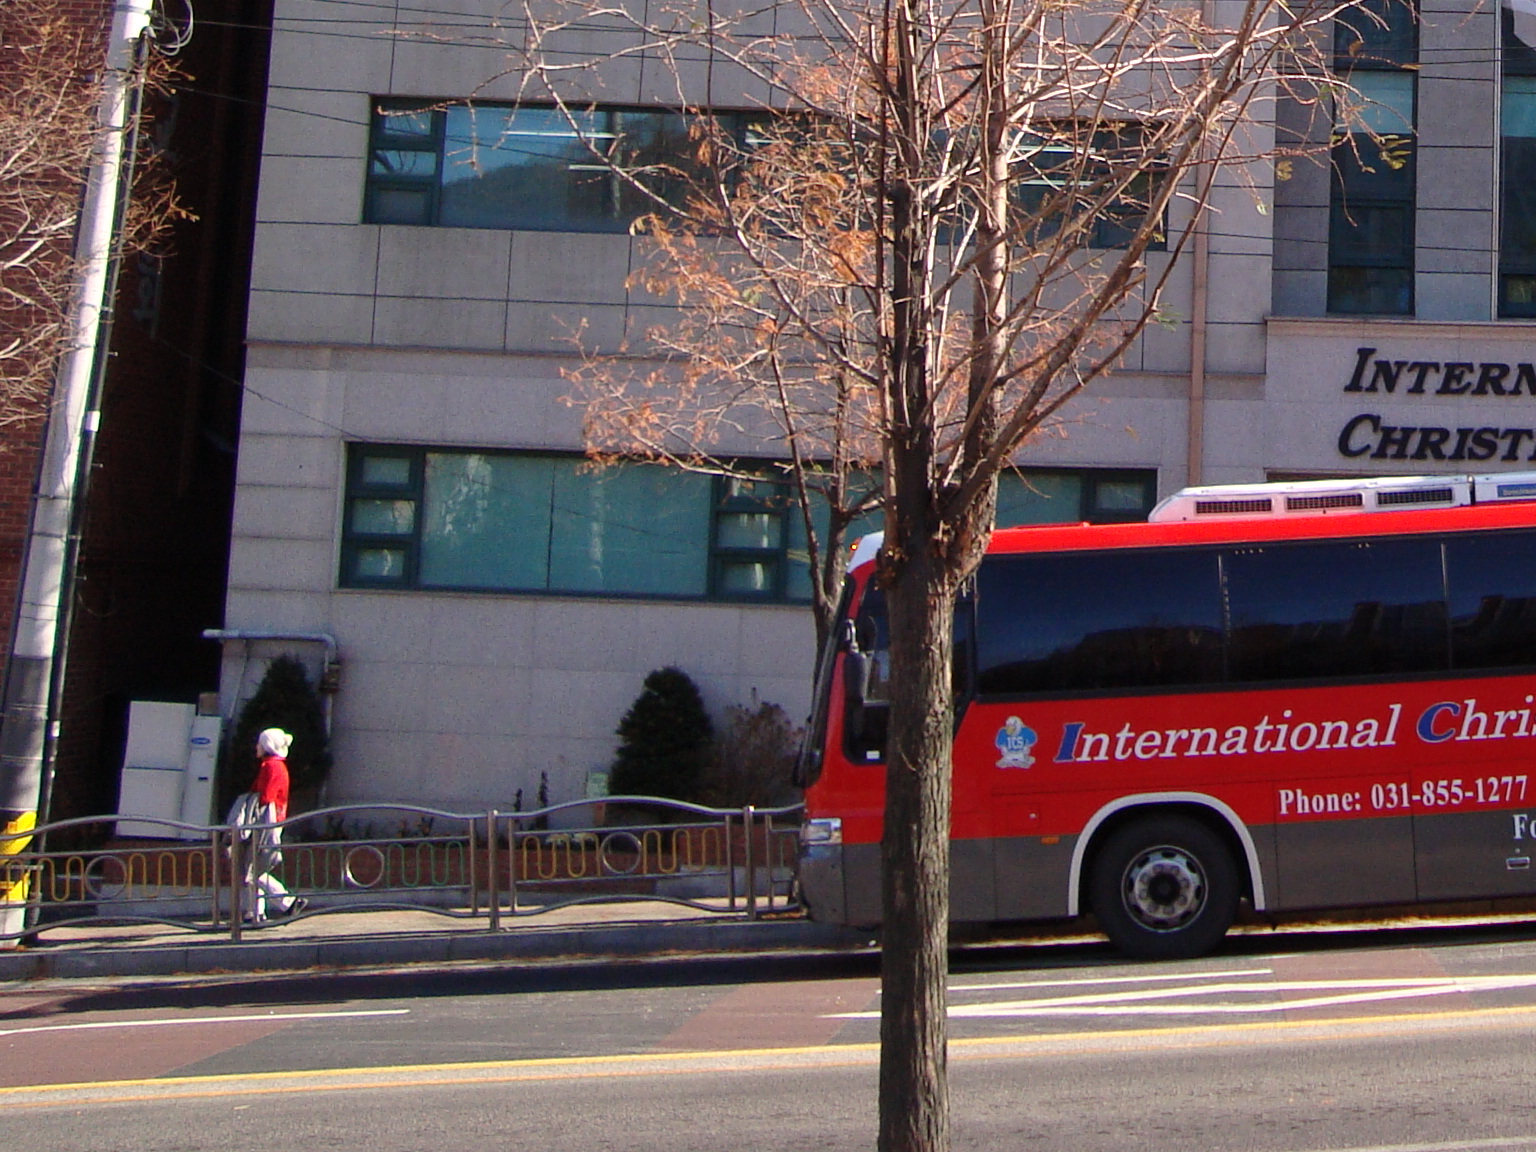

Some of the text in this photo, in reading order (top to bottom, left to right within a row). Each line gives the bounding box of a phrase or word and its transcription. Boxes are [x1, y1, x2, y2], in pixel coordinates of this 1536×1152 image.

[1053, 704, 1402, 763] International
[1279, 775, 1528, 815] Phone: 031-855-1277
